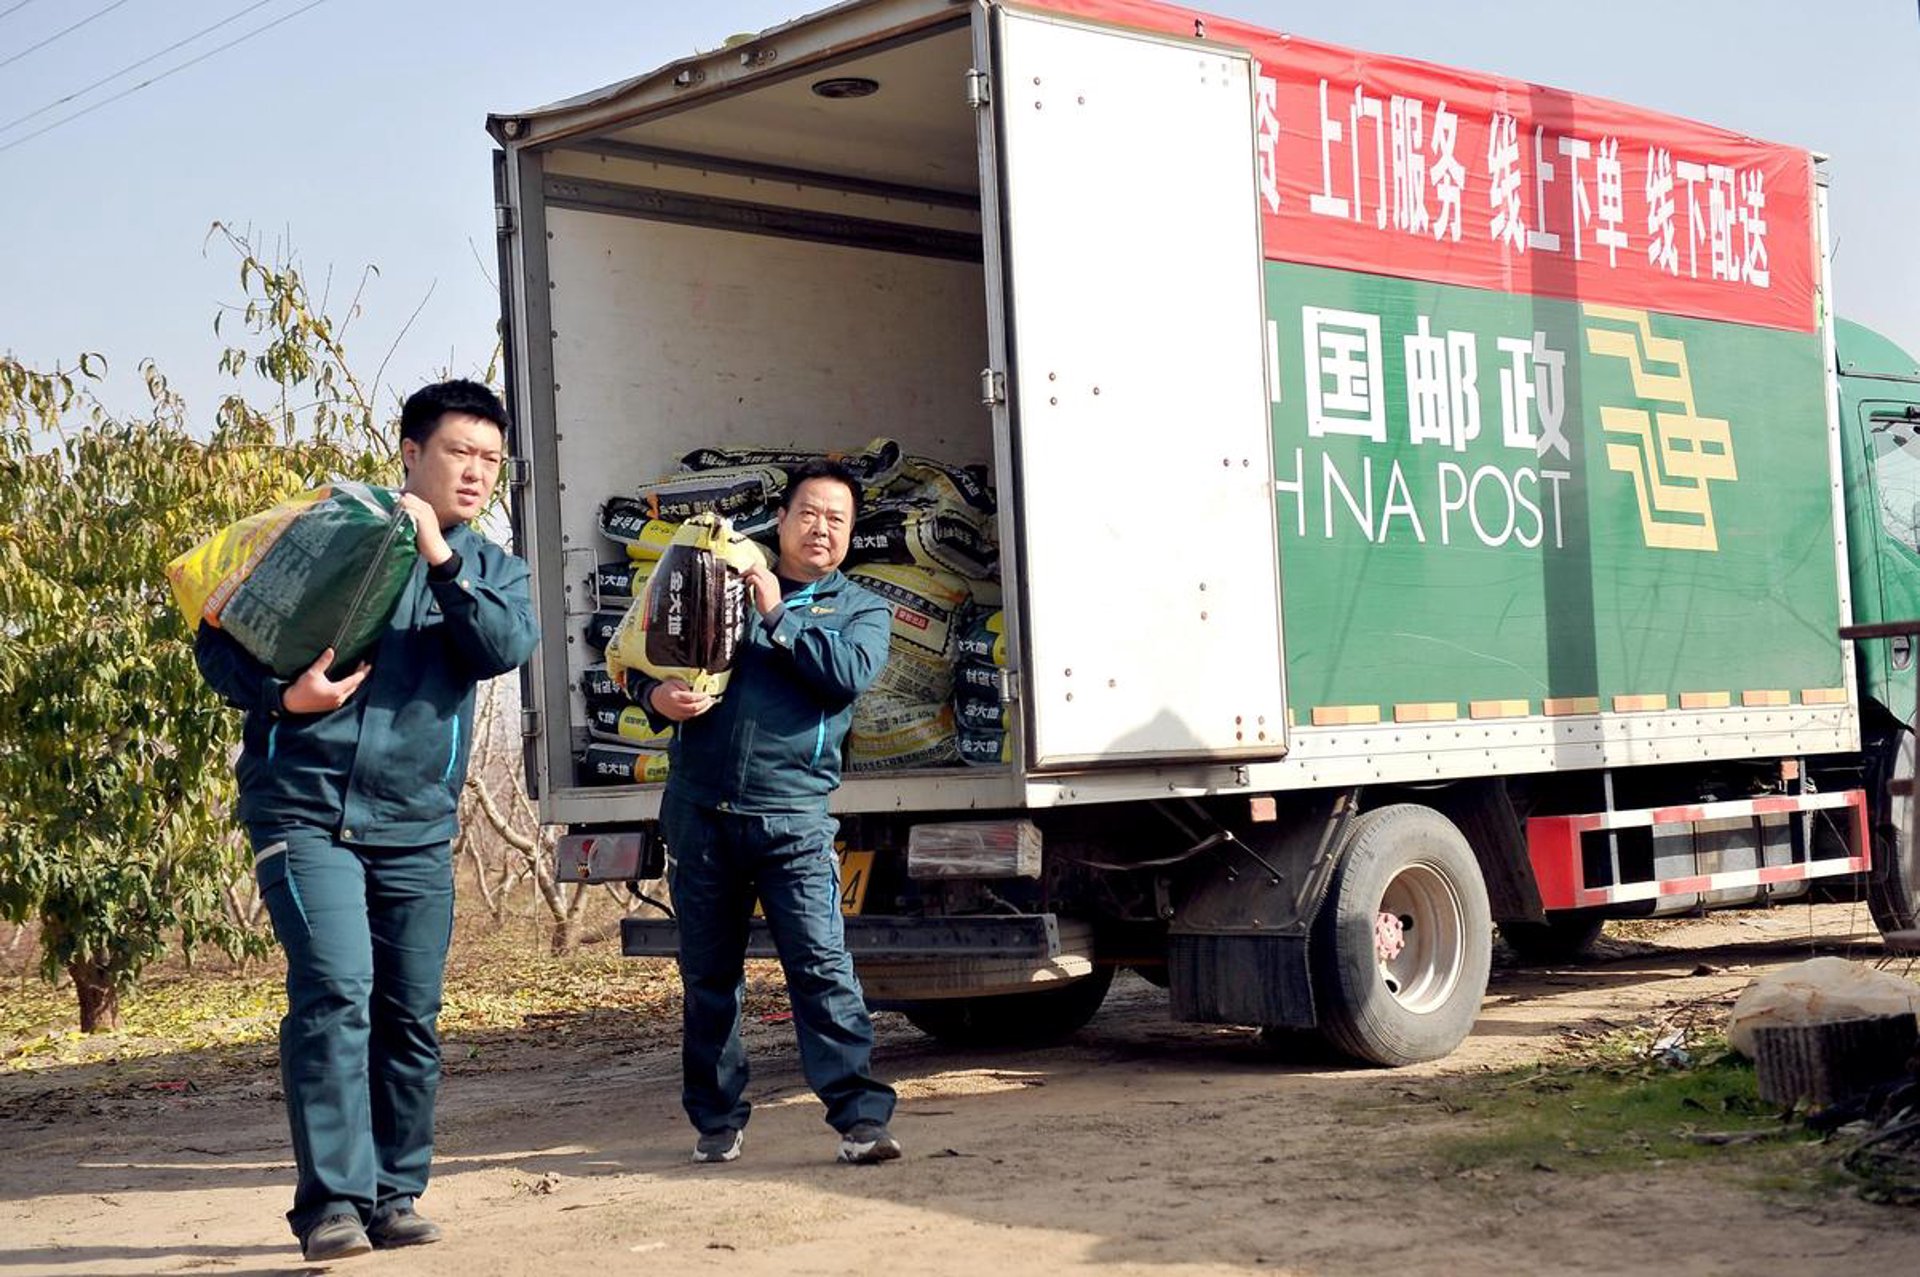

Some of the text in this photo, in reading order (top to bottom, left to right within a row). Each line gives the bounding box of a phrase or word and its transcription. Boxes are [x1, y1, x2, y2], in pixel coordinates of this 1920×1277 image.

[1310, 79, 1466, 243] 上门服务
[1487, 112, 1629, 269] 线上下单
[1645, 145, 1771, 288] 线下配送
[1268, 305, 1572, 462] 国邮政
[852, 534, 889, 549] 金大地
[1439, 462, 1572, 550] POST
[668, 571, 684, 636] 金大地
[597, 762, 631, 777] 金大地
